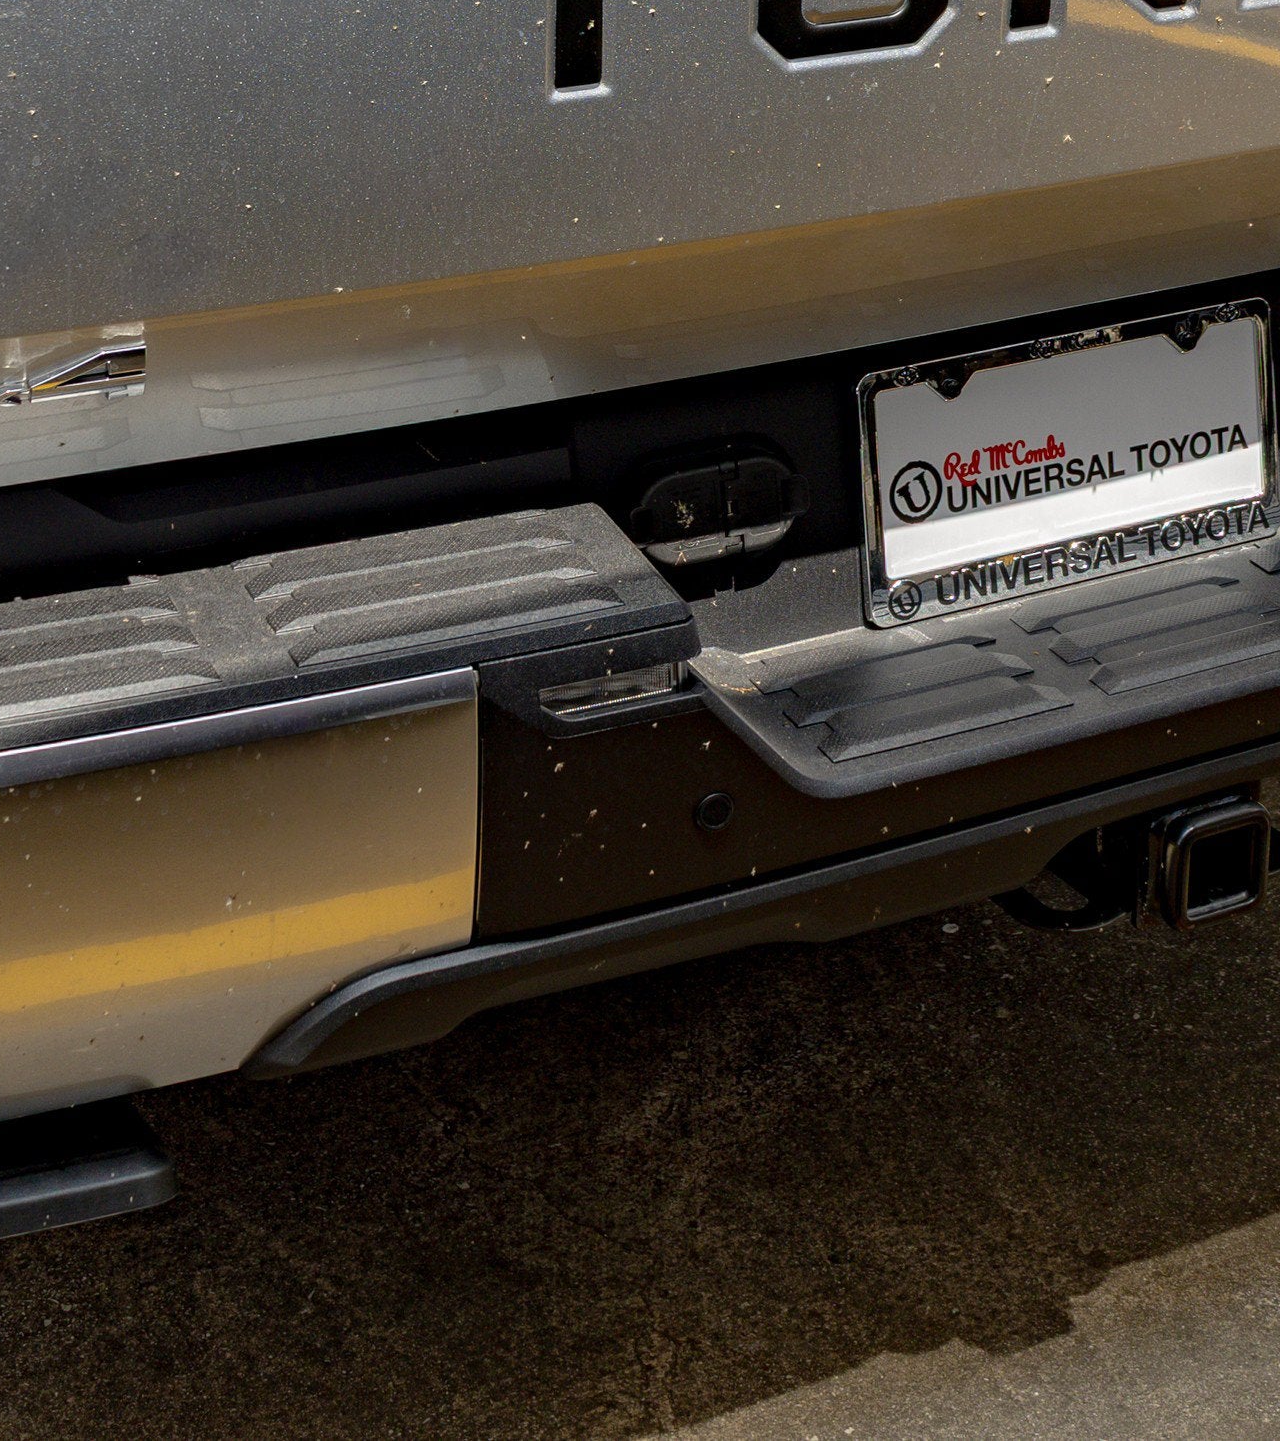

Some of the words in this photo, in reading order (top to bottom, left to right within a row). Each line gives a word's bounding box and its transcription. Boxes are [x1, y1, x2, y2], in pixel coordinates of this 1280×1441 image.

[943, 449, 982, 487] Red
[947, 451, 1125, 513] UNIVERSAL
[1129, 424, 1249, 472] TOYOTA
[934, 532, 1137, 606] UNIVERSAL
[1137, 500, 1270, 556] TOYOTA
